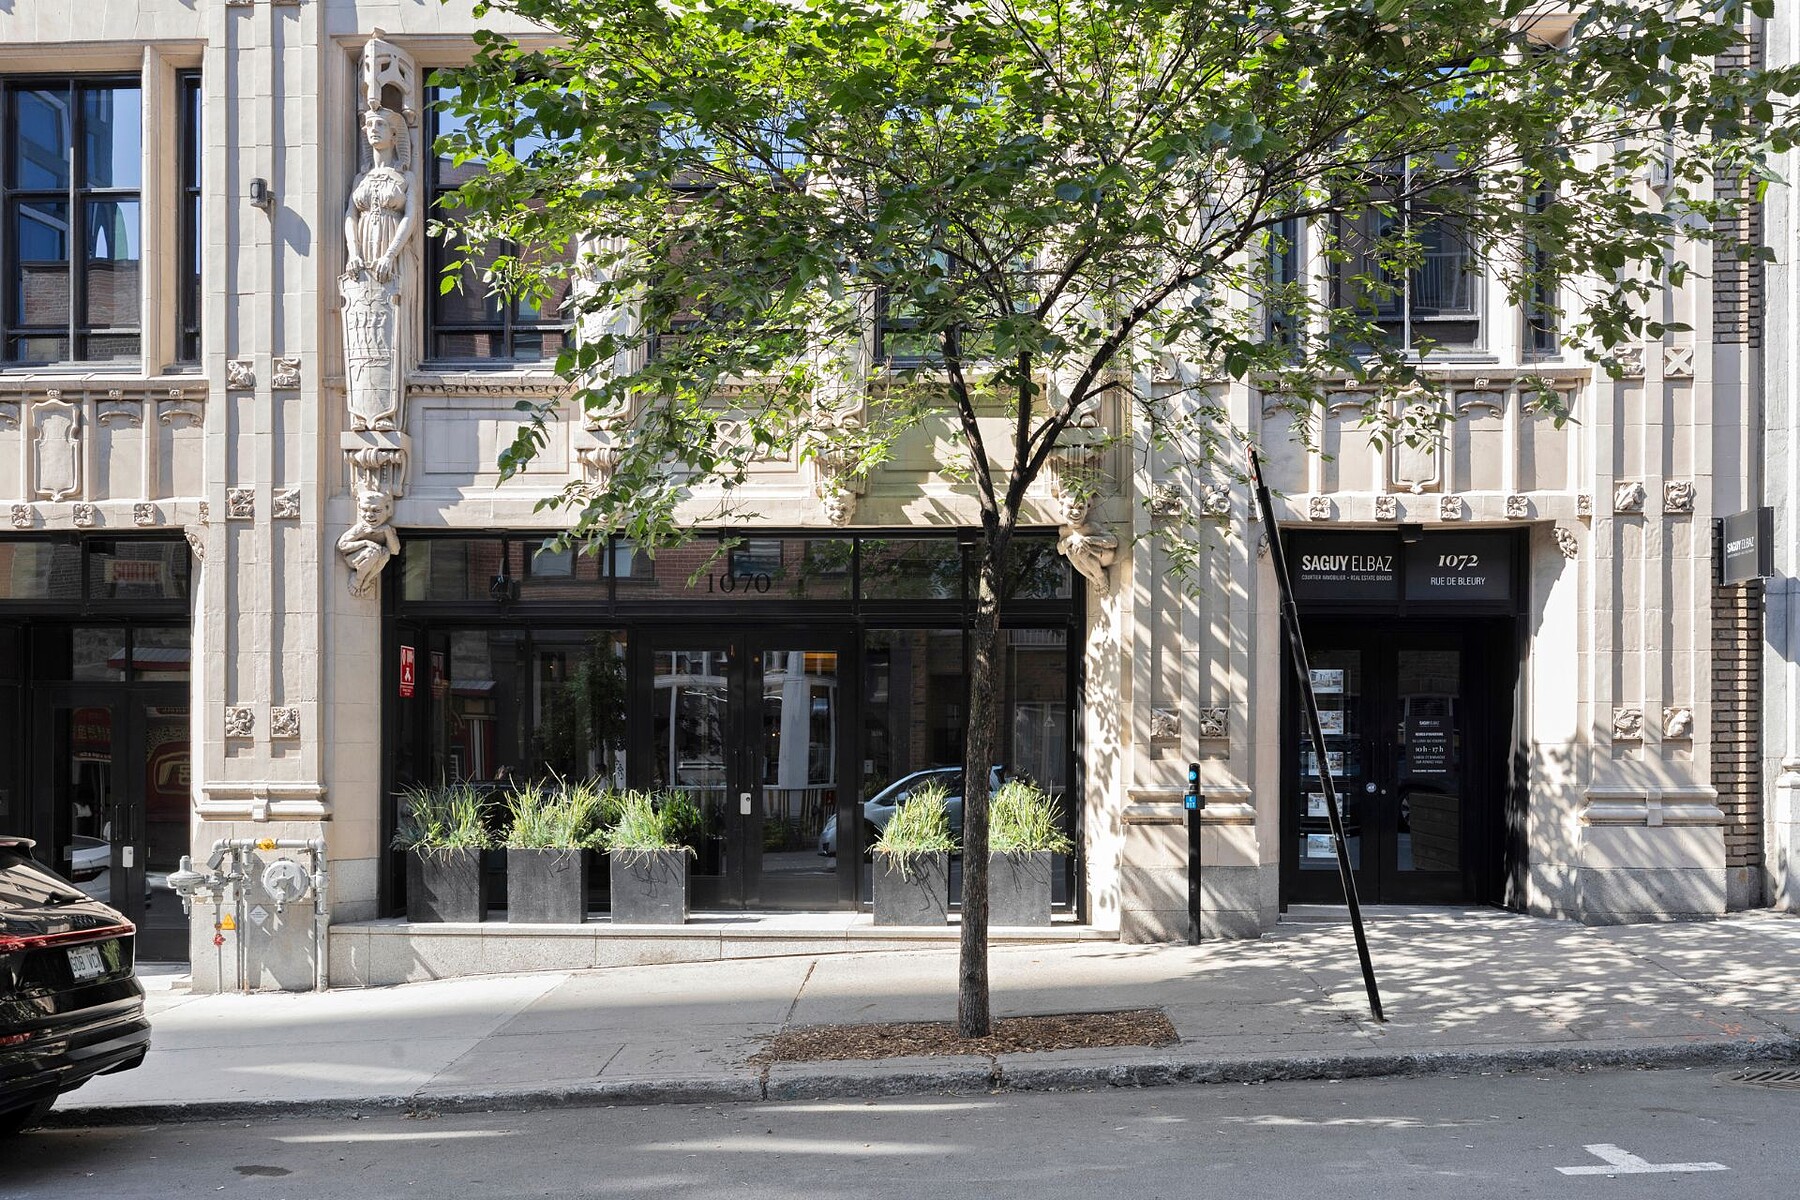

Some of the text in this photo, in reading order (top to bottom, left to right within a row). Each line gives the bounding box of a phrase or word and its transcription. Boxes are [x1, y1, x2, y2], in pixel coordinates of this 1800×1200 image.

[1302, 555, 1393, 571] SAGUY ELBAZ
[1438, 554, 1480, 571] 1072
[705, 572, 771, 593] 1070
[1430, 576, 1486, 586] RUE DE BLEURY
